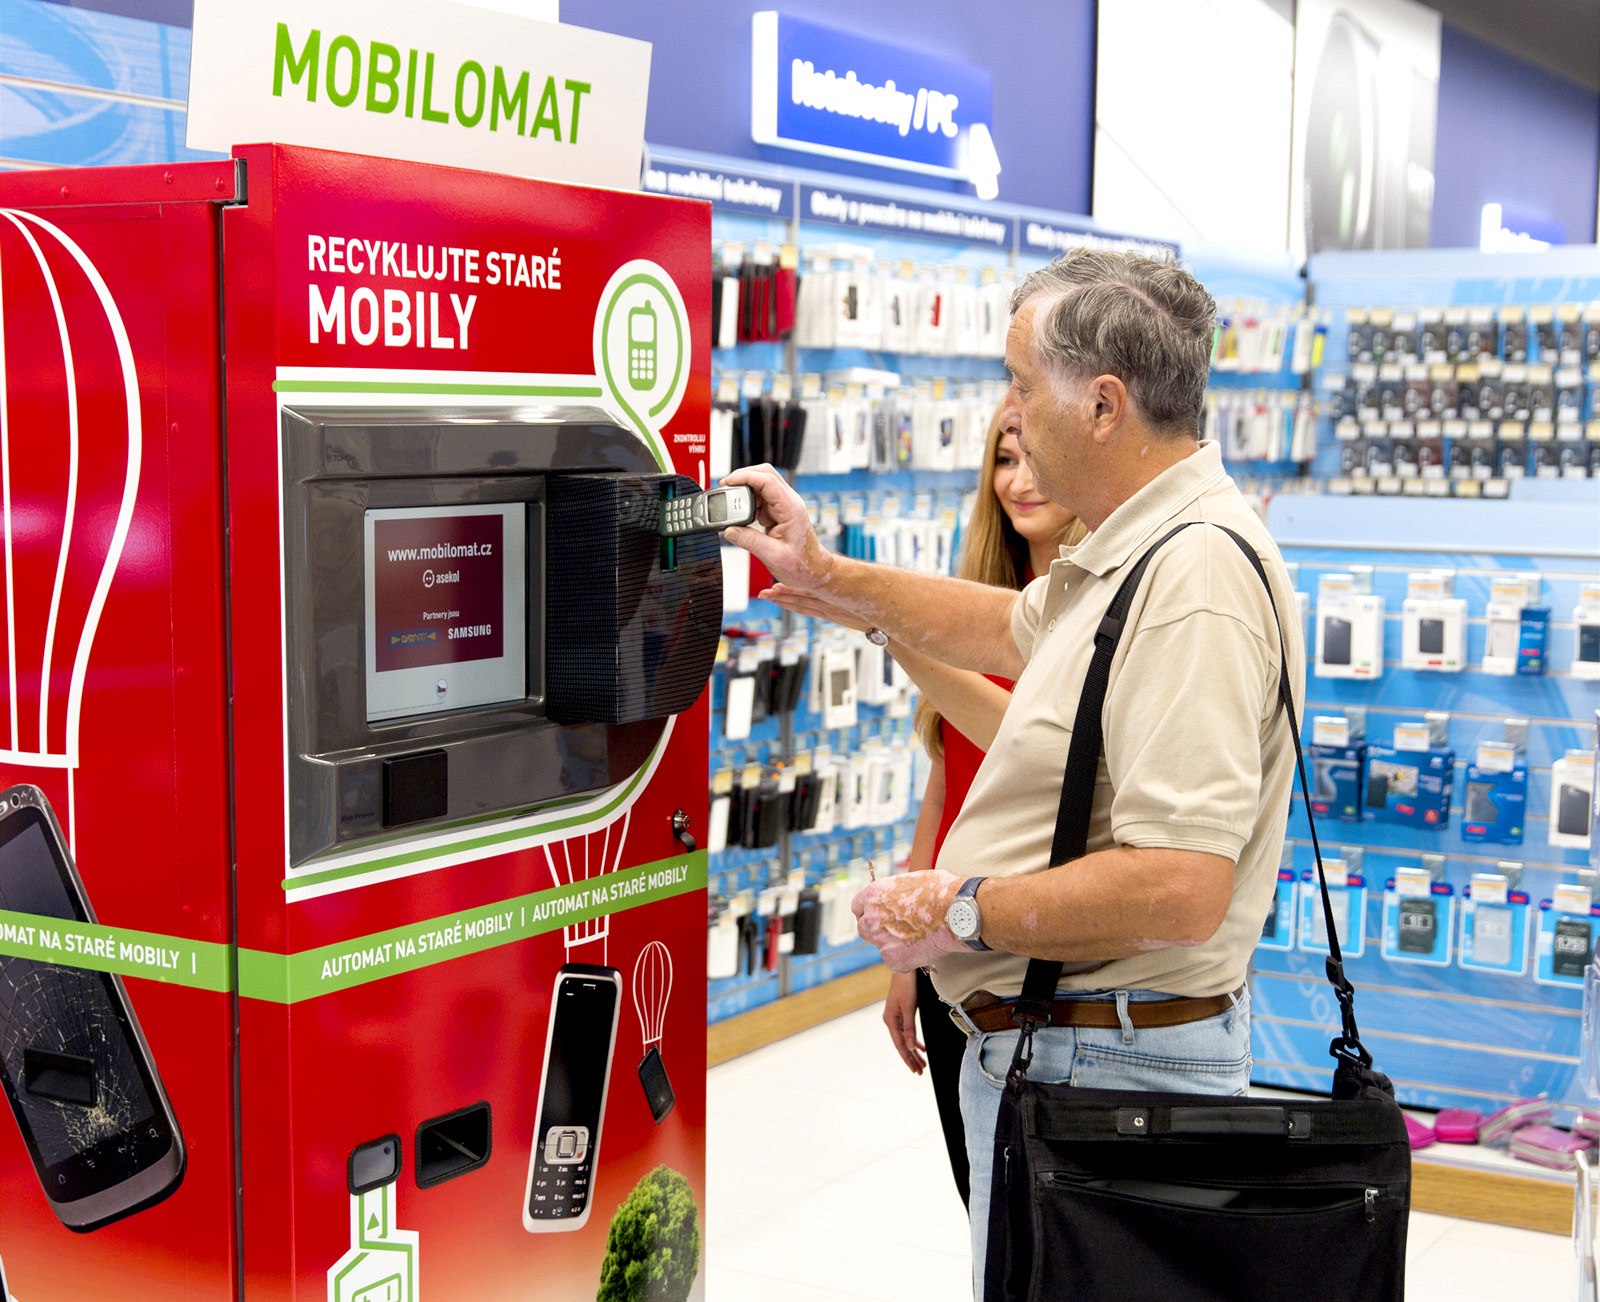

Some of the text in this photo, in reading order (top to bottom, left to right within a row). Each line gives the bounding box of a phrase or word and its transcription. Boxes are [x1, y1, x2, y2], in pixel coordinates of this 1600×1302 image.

[271, 23, 591, 144] MOBILOMAT
[308, 234, 562, 290] RECYKLUJTE STARÉ
[308, 284, 477, 350] MOBILY
[388, 542, 492, 562] www.mobilomat.cz
[436, 570, 460, 584] asekol
[422, 611, 448, 620] Partnery
[448, 624, 492, 640] SAMSUNG
[532, 865, 688, 922] AUTOMAT NA STARÉ MOBILY
[0, 924, 180, 969] MAT NA STARÉ MOBILY
[321, 911, 513, 980] AUTOMAT NA STARÉ MOBILY
